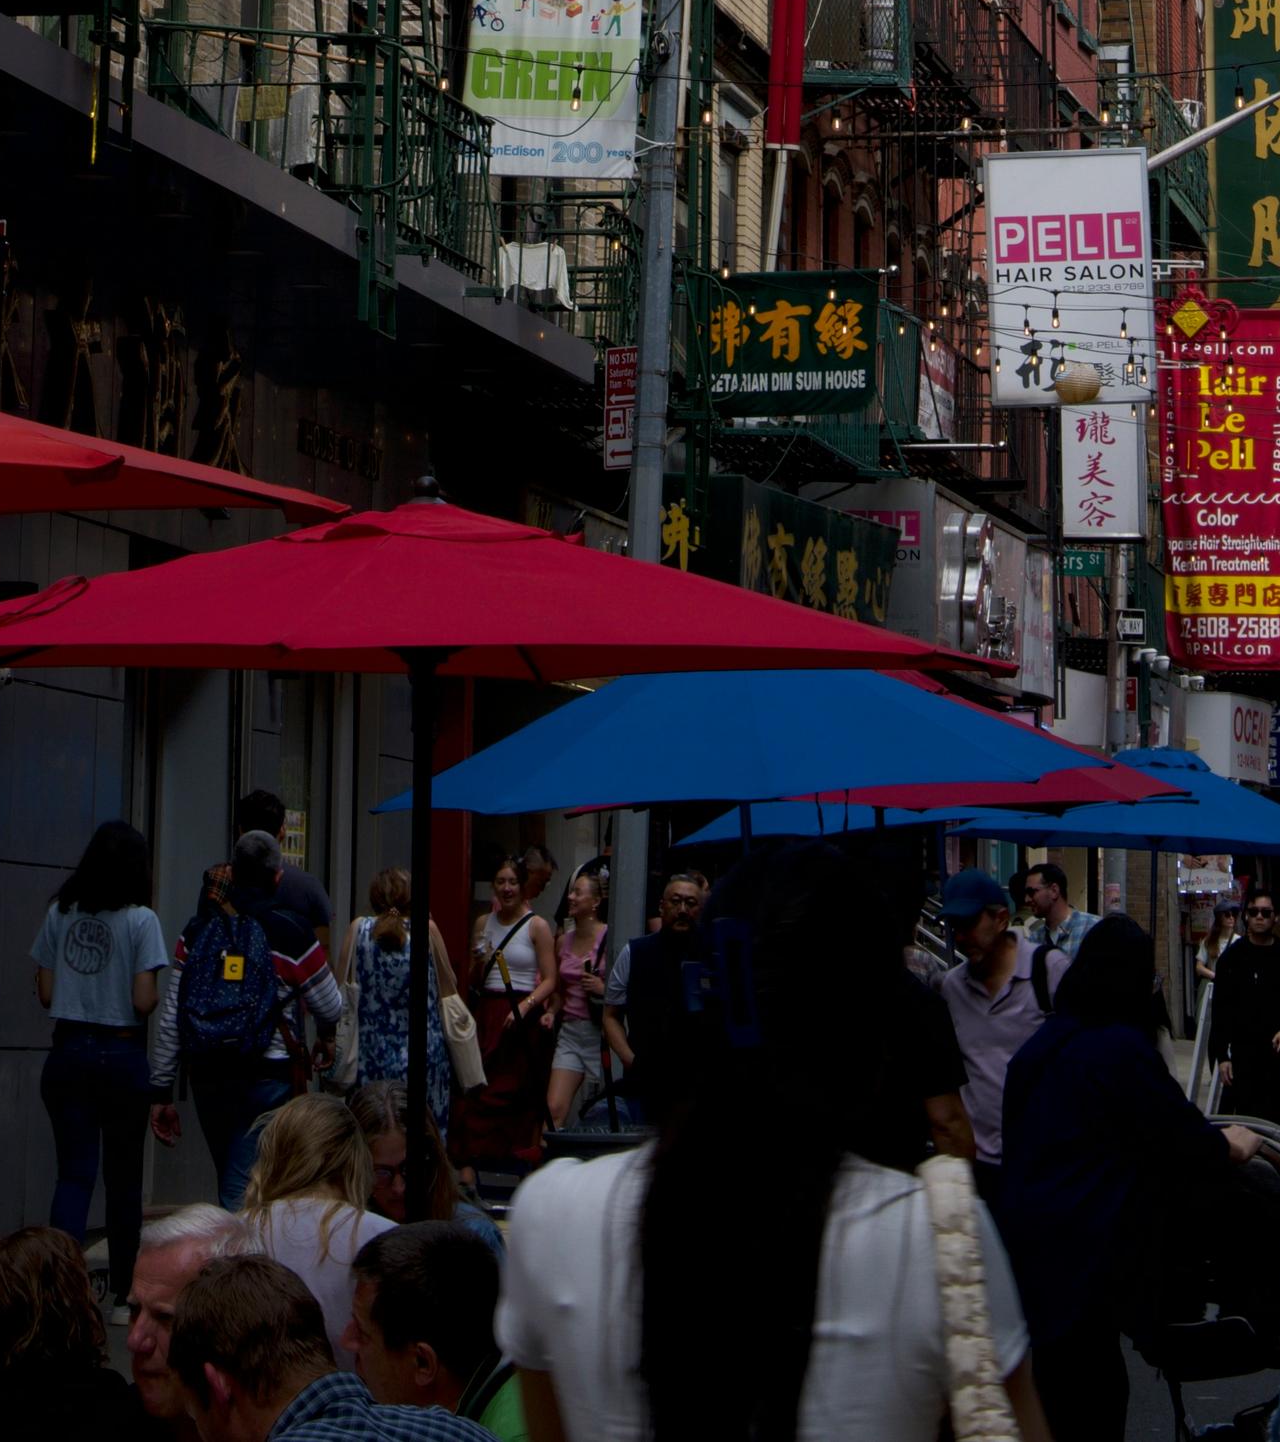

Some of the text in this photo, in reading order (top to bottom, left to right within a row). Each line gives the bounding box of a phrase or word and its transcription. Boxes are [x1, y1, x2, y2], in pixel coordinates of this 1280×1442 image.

[470, 47, 613, 101] GREEN
[491, 144, 545, 157] onEdison
[551, 141, 604, 164] 200
[998, 218, 1136, 258] PELL
[996, 263, 1145, 284] HAIR SALON
[1096, 340, 1127, 350] PELL
[771, 372, 793, 392] DIM
[795, 371, 822, 391] SUM
[825, 369, 866, 390] HOUSE
[1198, 402, 1246, 433] Le
[1196, 508, 1239, 527] Color
[1199, 535, 1220, 551] Hair
[1062, 553, 1100, 570] ers St
[1180, 617, 1280, 639] 2-608-2588
